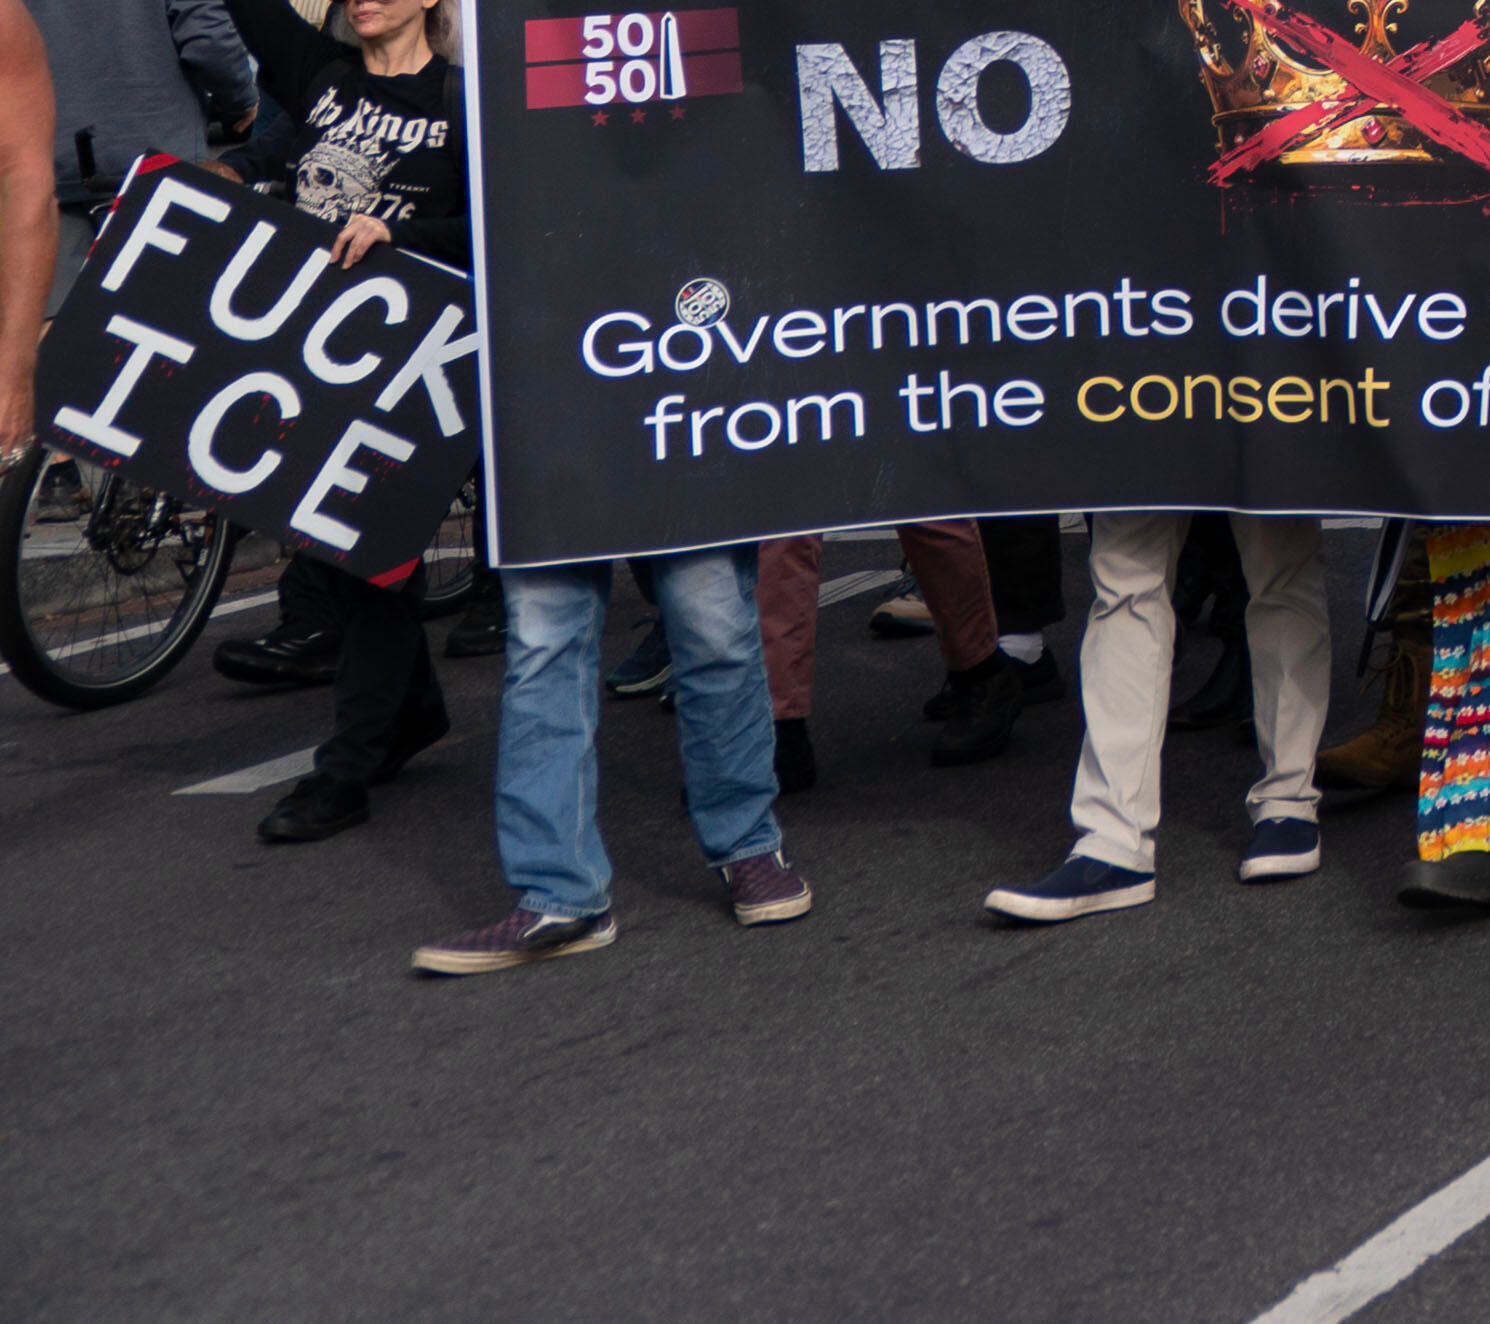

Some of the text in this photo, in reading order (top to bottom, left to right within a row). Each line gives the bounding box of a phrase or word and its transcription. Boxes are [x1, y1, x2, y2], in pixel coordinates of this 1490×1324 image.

[582, 13, 654, 57] 50
[583, 60, 657, 106] 50
[331, 97, 449, 153] Kings
[796, 30, 1072, 173] NO
[100, 176, 481, 439] FUCK
[582, 275, 1195, 378] Governments
[1220, 273, 1467, 342] derive
[53, 314, 416, 551] ICE
[643, 390, 866, 461] from
[898, 370, 1046, 433] the
[1076, 366, 1391, 431] consent
